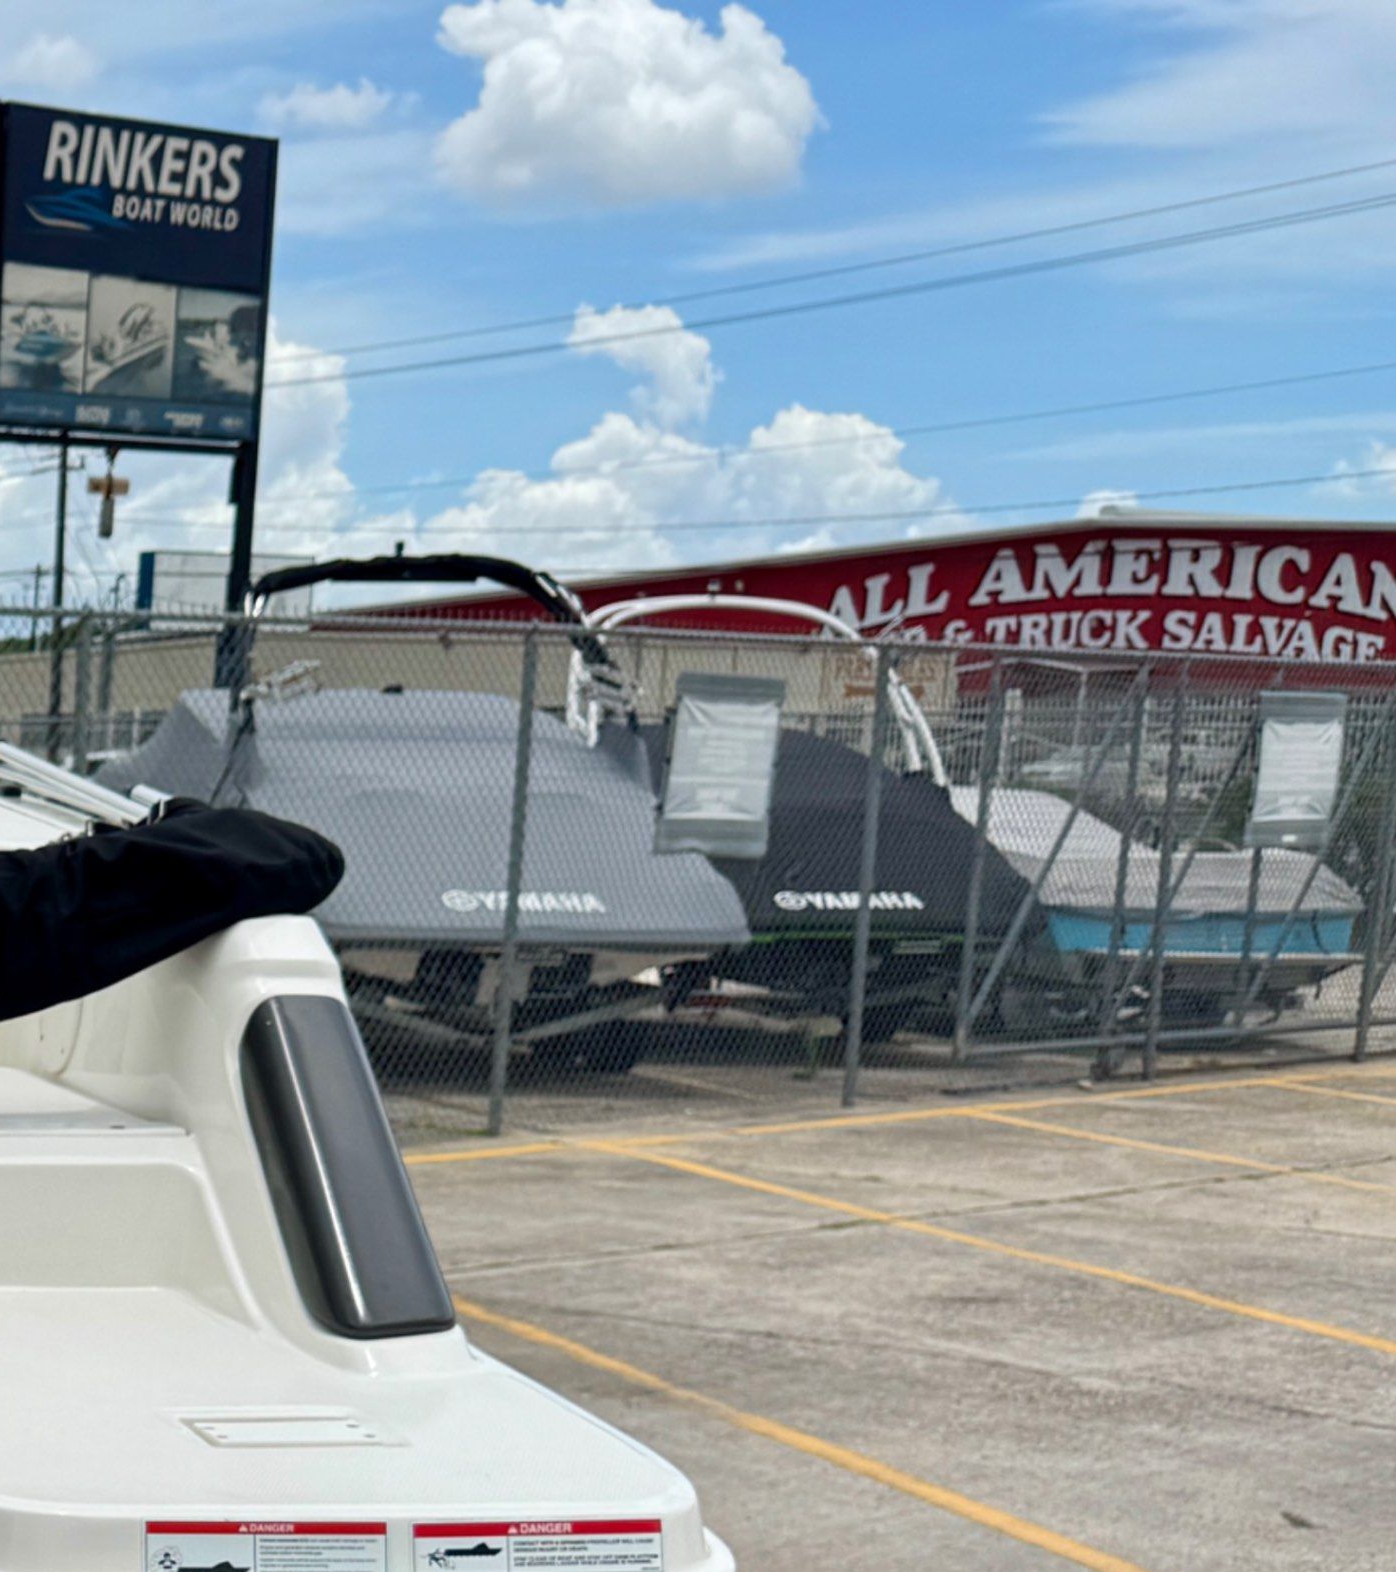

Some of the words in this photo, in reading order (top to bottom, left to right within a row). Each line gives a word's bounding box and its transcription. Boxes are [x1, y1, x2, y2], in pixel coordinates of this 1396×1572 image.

[42, 120, 245, 204] RINKERS
[112, 194, 164, 224] BOAT
[170, 201, 240, 233] WORLD
[820, 562, 950, 640] ALL
[969, 538, 1396, 622] AMERICAN
[985, 609, 1151, 650] TRUCK
[1161, 609, 1387, 663] SALVAGE
[249, 1522, 295, 1534] DANGER
[520, 1522, 573, 1535] DANGER
